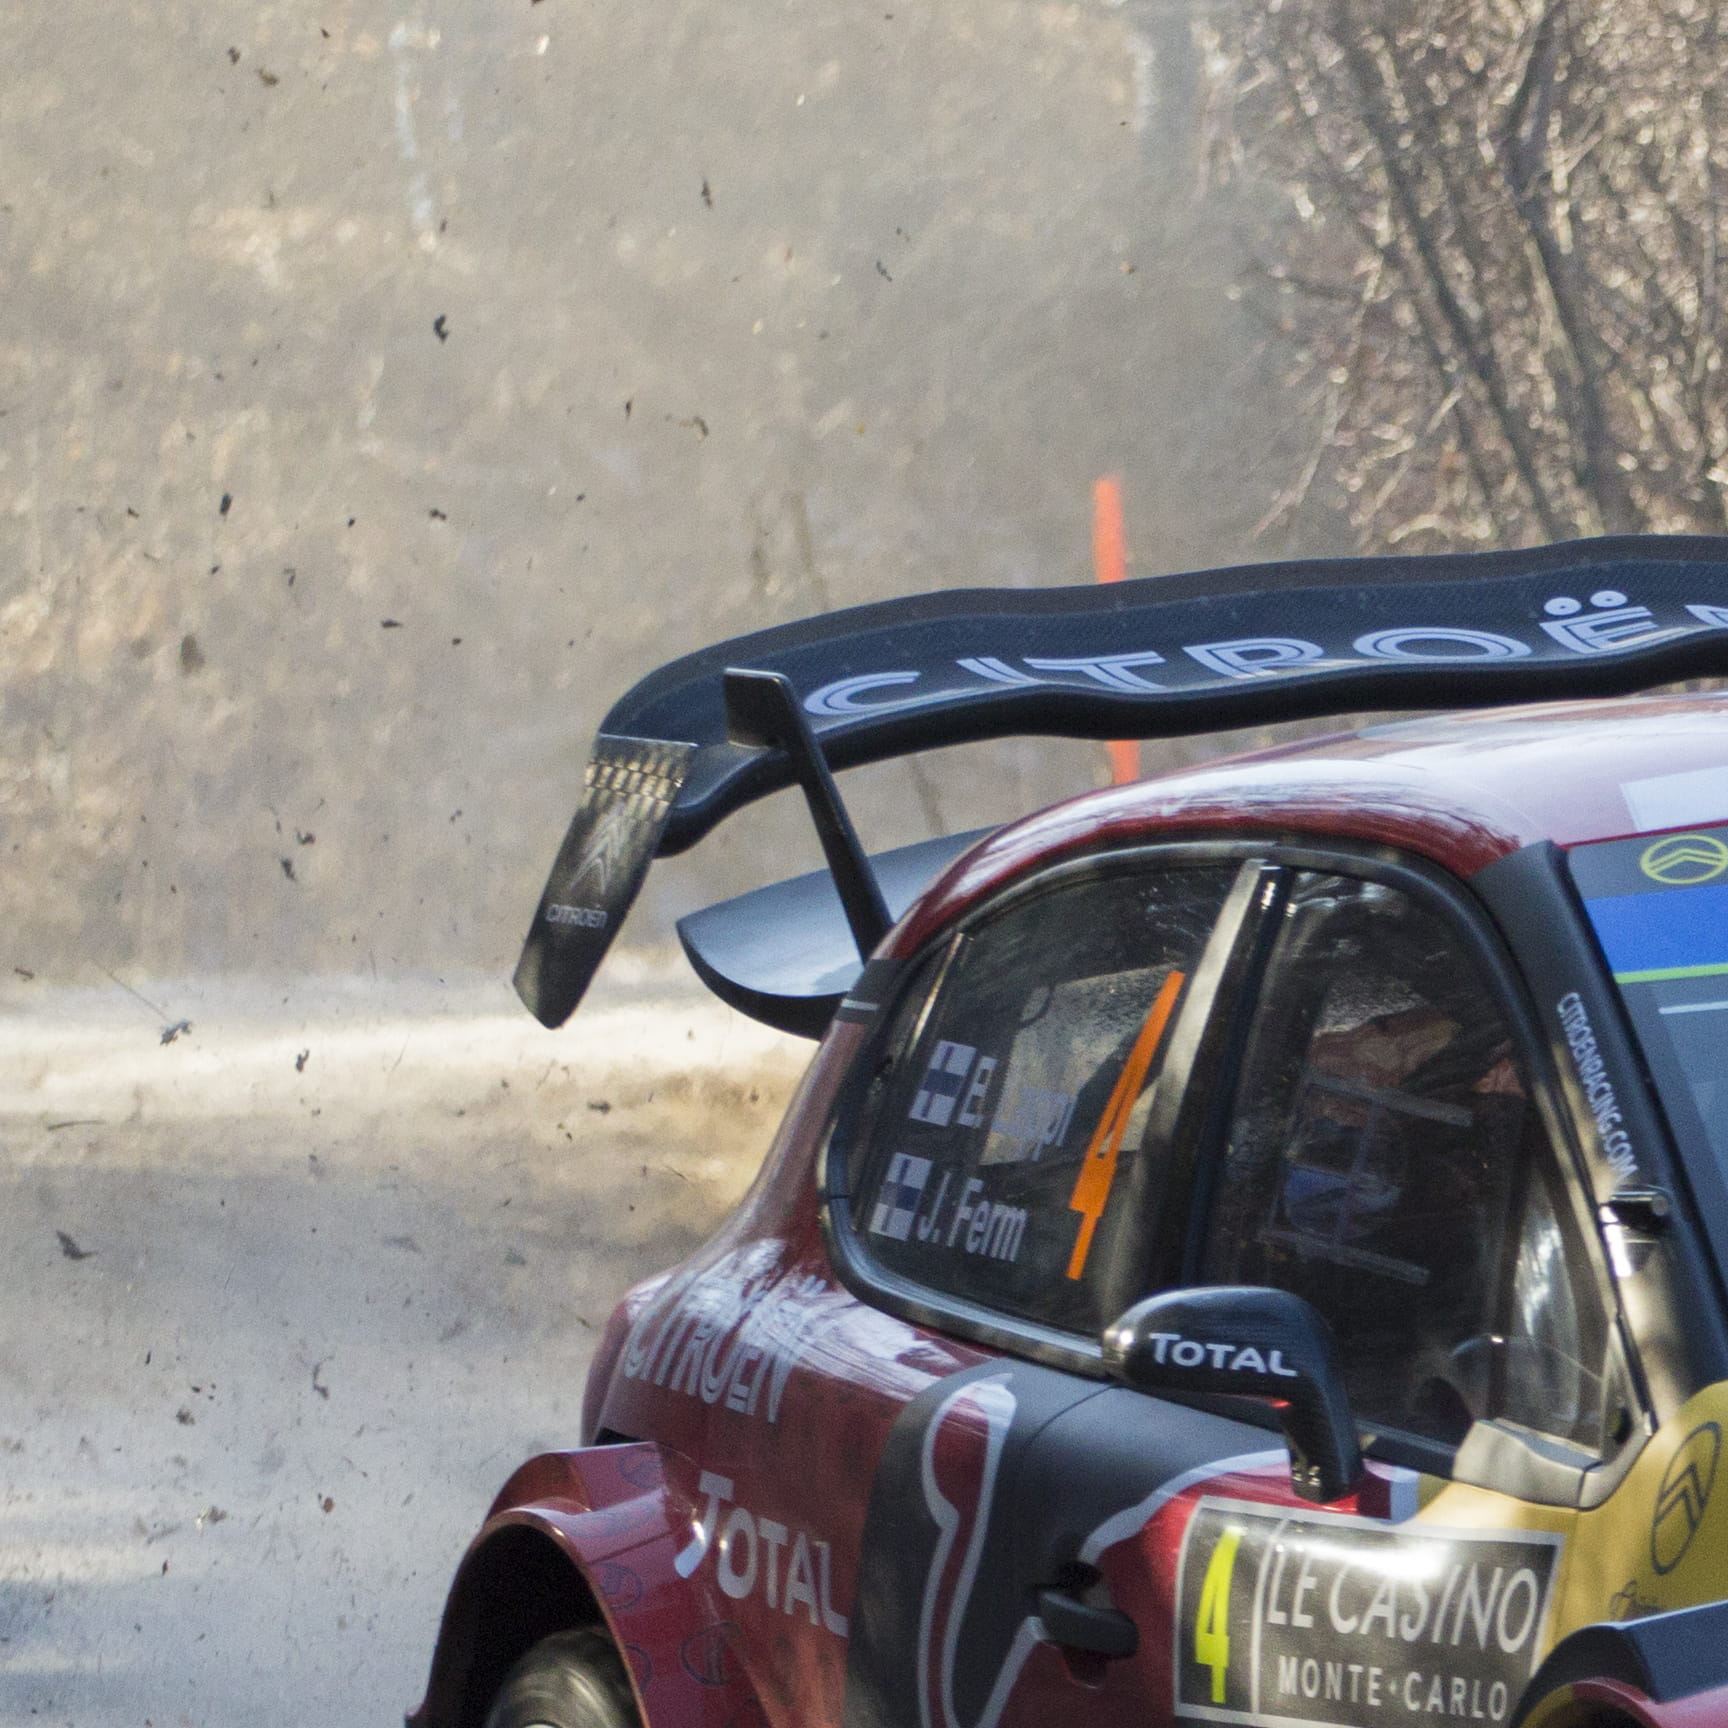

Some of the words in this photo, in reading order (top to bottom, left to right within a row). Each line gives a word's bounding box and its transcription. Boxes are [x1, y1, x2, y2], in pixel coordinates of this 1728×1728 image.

[1148, 1331, 1298, 1378] TOTAL
[674, 1470, 849, 1638] TOTAL
[1195, 1525, 1246, 1704] 4
